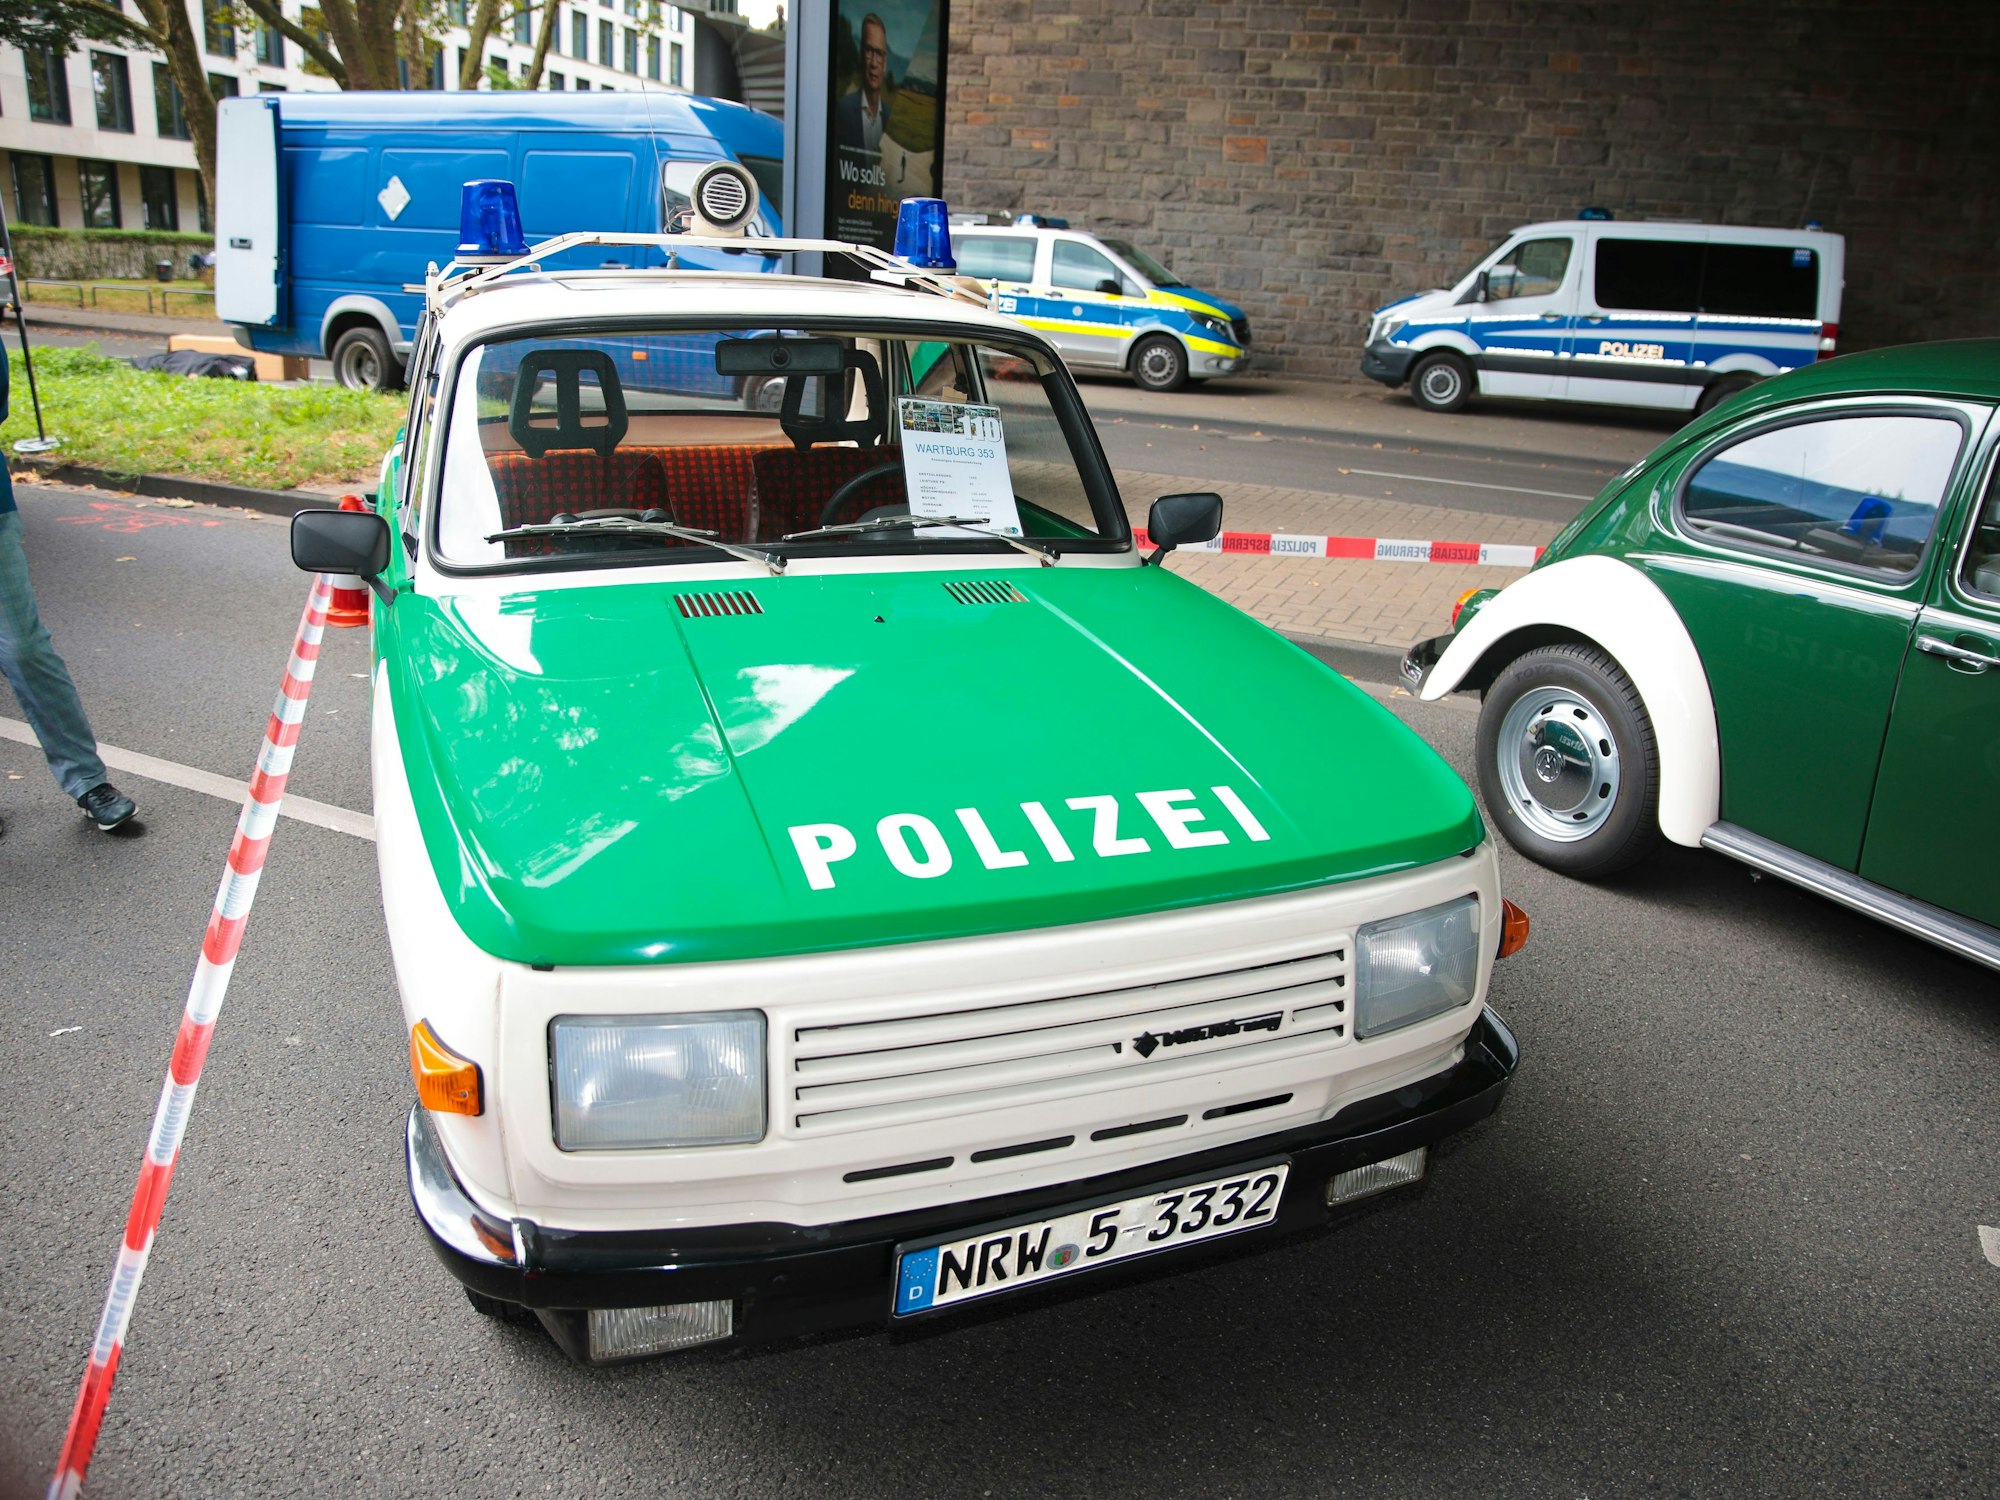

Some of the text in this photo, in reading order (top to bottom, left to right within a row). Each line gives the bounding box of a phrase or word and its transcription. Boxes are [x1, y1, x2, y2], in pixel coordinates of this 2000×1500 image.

[840, 159, 886, 187] Wo soll's
[848, 188, 875, 212] denn
[1599, 341, 1665, 359] POLIZEI
[956, 415, 1002, 443] 110
[915, 443, 995, 459] WARTBURG 353
[787, 785, 1271, 891] POLIZEI
[909, 1285, 923, 1301] D
[937, 1226, 1053, 1296] NRW
